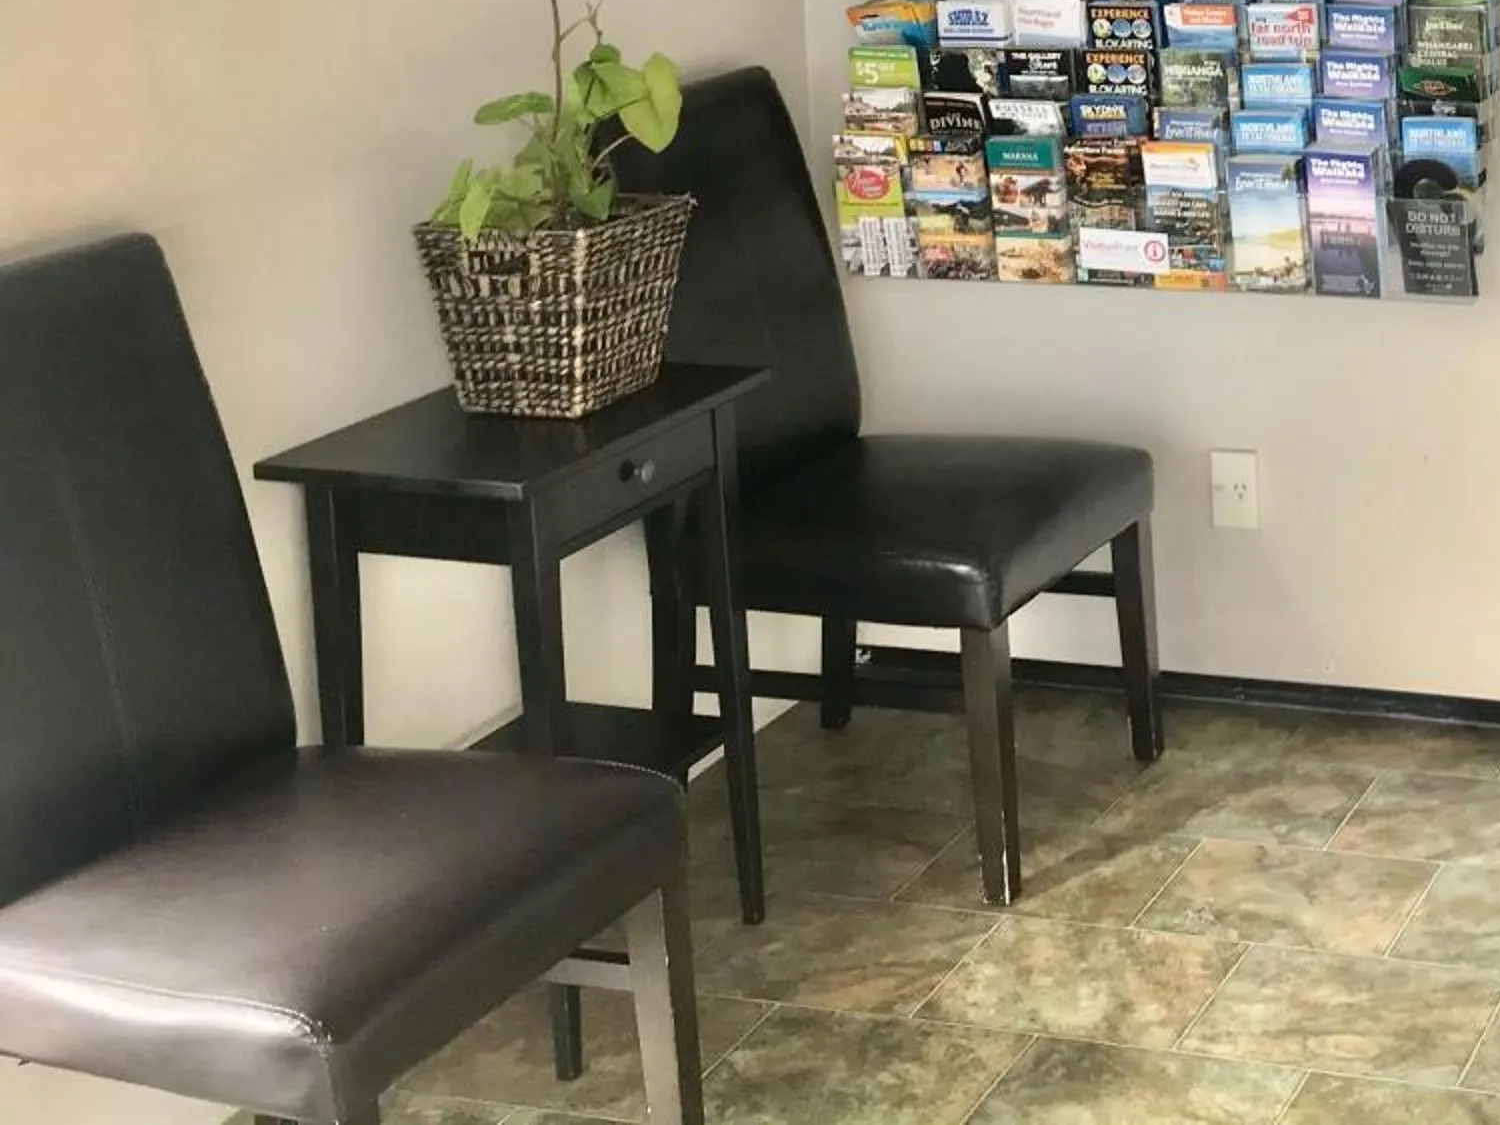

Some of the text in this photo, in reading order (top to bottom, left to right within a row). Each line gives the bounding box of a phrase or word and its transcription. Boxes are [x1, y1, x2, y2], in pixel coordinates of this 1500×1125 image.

[1091, 7, 1150, 19] EXPERIENCE
[1332, 13, 1350, 22] The
[1273, 22, 1312, 34] north
[1333, 21, 1386, 33] Waikato
[1086, 53, 1145, 65] EXPERIENCE
[1326, 61, 1345, 71] The
[1327, 70, 1380, 81] Waikato
[1089, 84, 1148, 96] BLOKARTING
[1310, 158, 1330, 168] The
[1311, 167, 1365, 179] Waikato
[1407, 210, 1426, 223] DO
